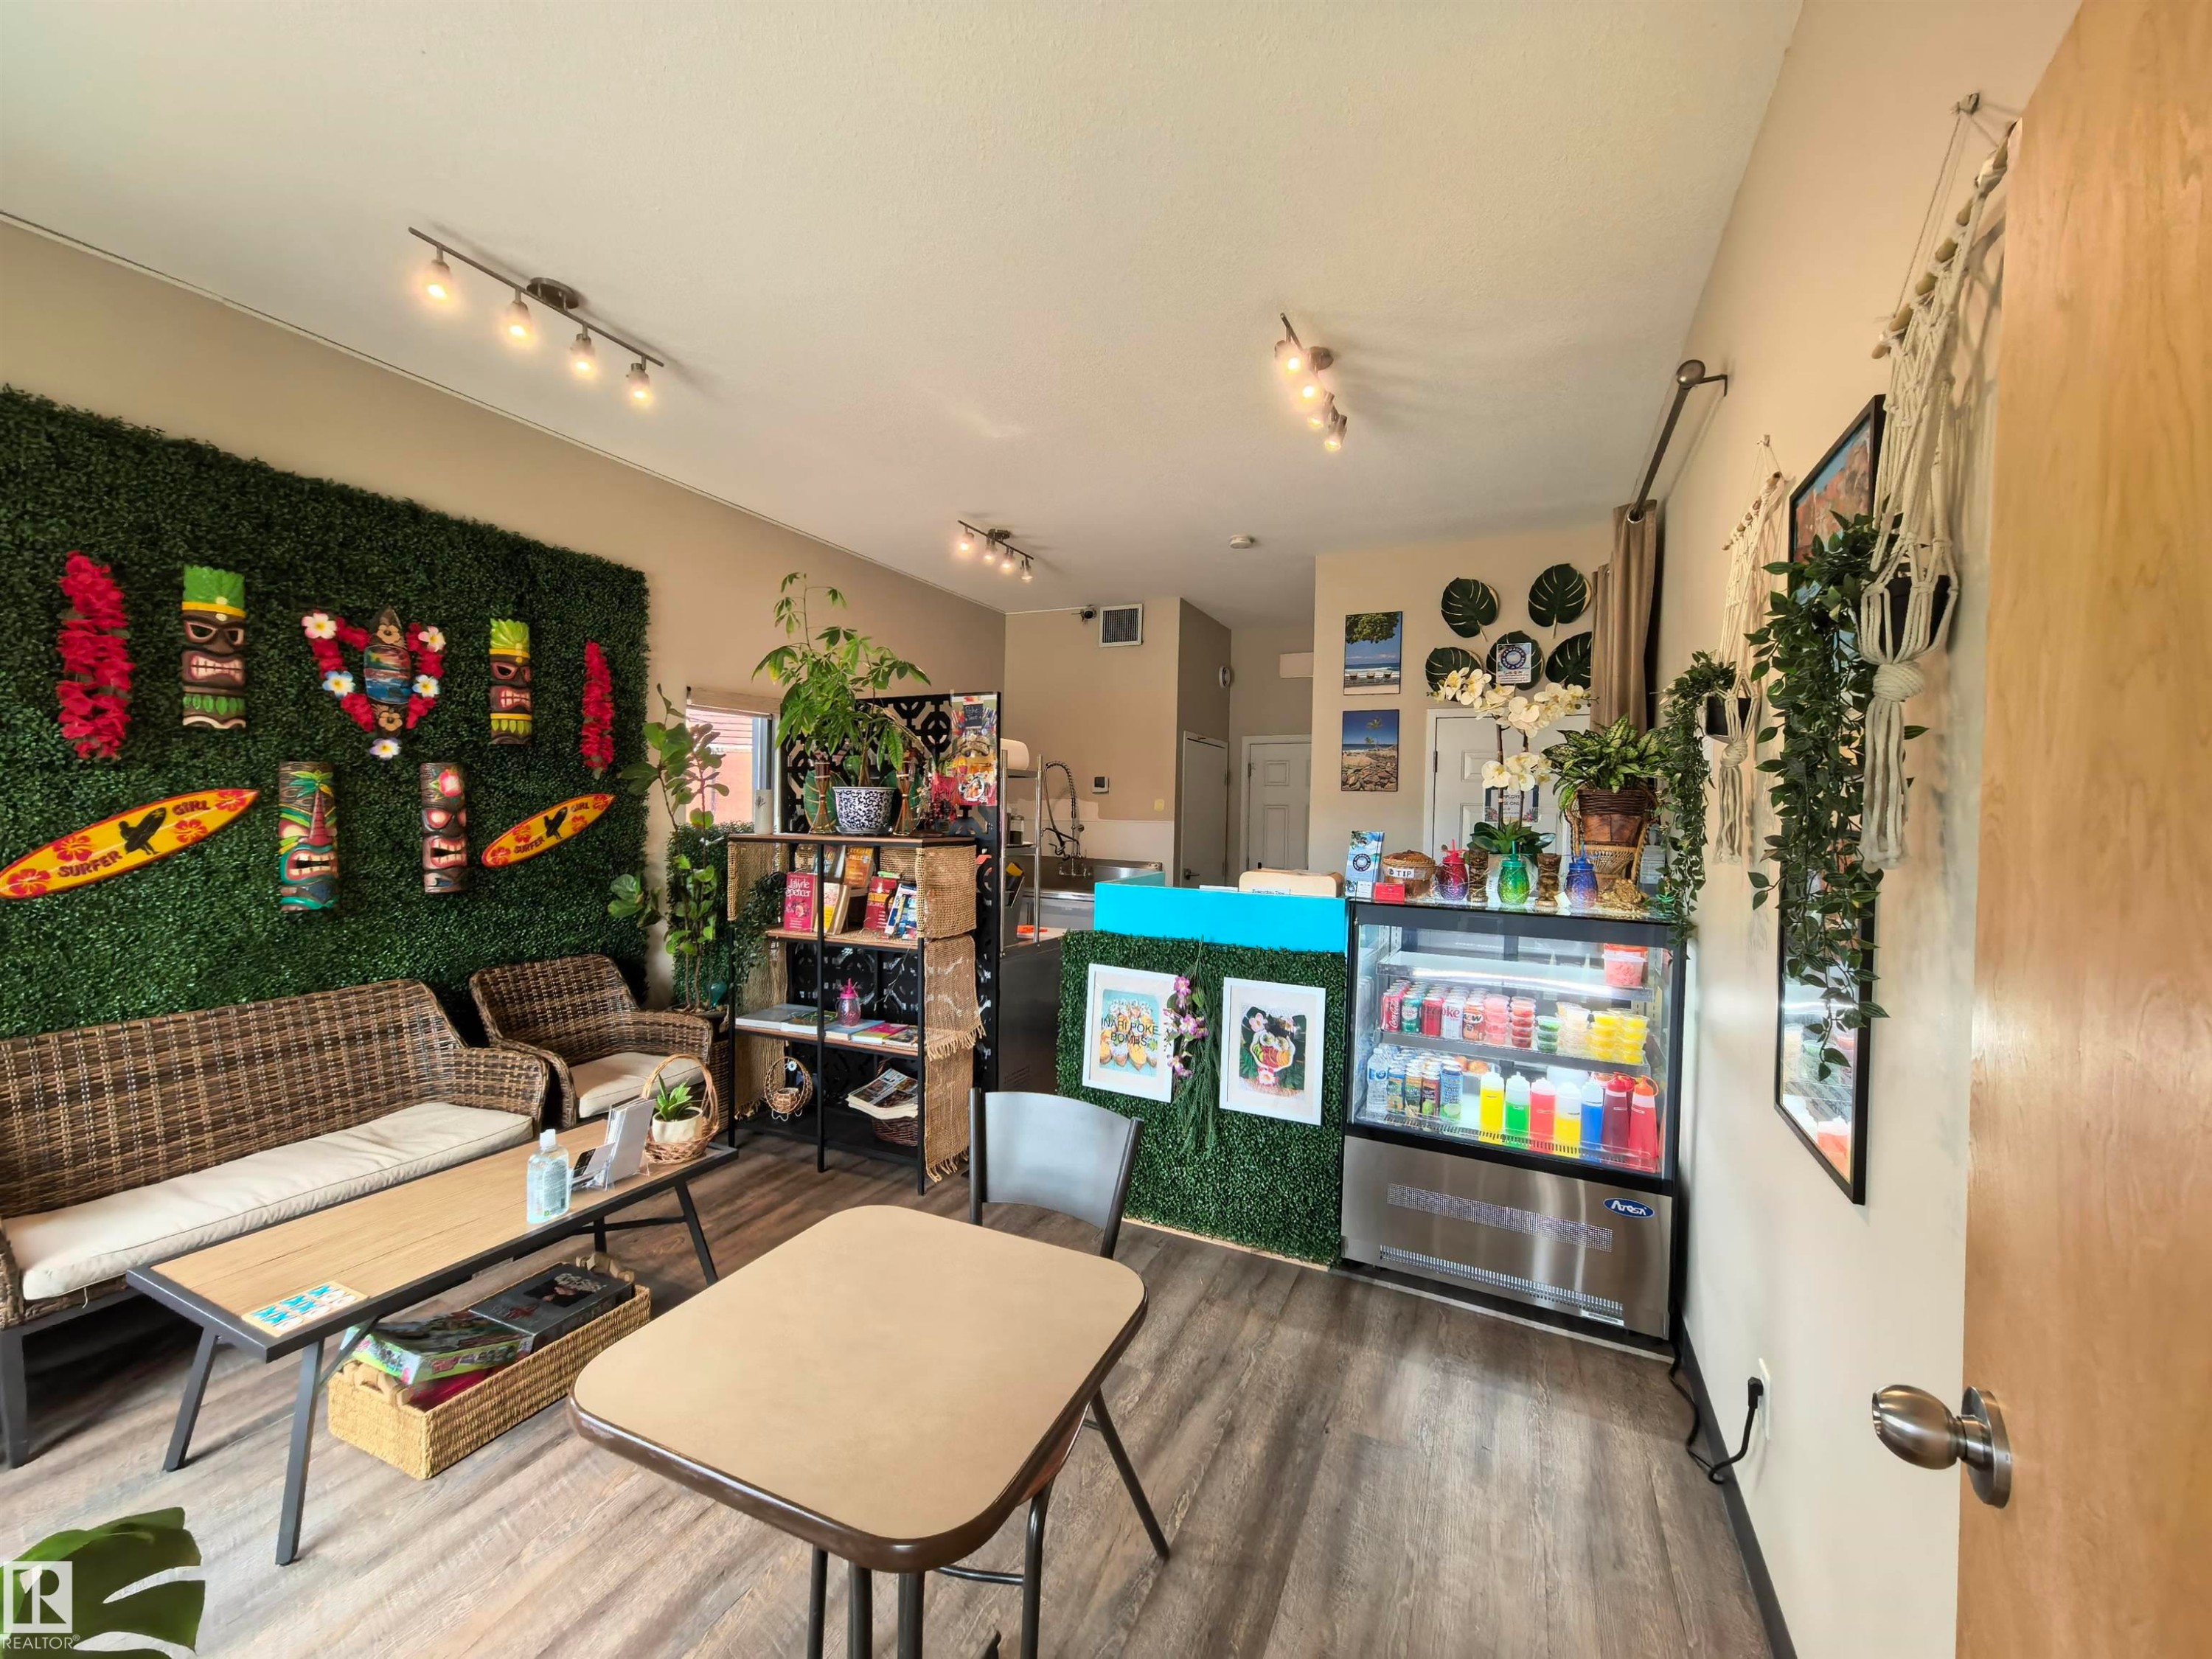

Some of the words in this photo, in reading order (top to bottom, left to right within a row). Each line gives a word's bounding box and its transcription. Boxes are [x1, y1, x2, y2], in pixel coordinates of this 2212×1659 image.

[514, 835, 546, 854] SURFER
[571, 801, 590, 813] GIRL
[57, 850, 124, 877] SURFER
[172, 800, 211, 815] GIRL
[785, 889, 811, 900] Spencer
[1441, 1006, 1461, 1018] oke
[1101, 1018, 1127, 1032] INARI
[1130, 1023, 1160, 1035] POKE
[1110, 1032, 1147, 1046] BOMBS
